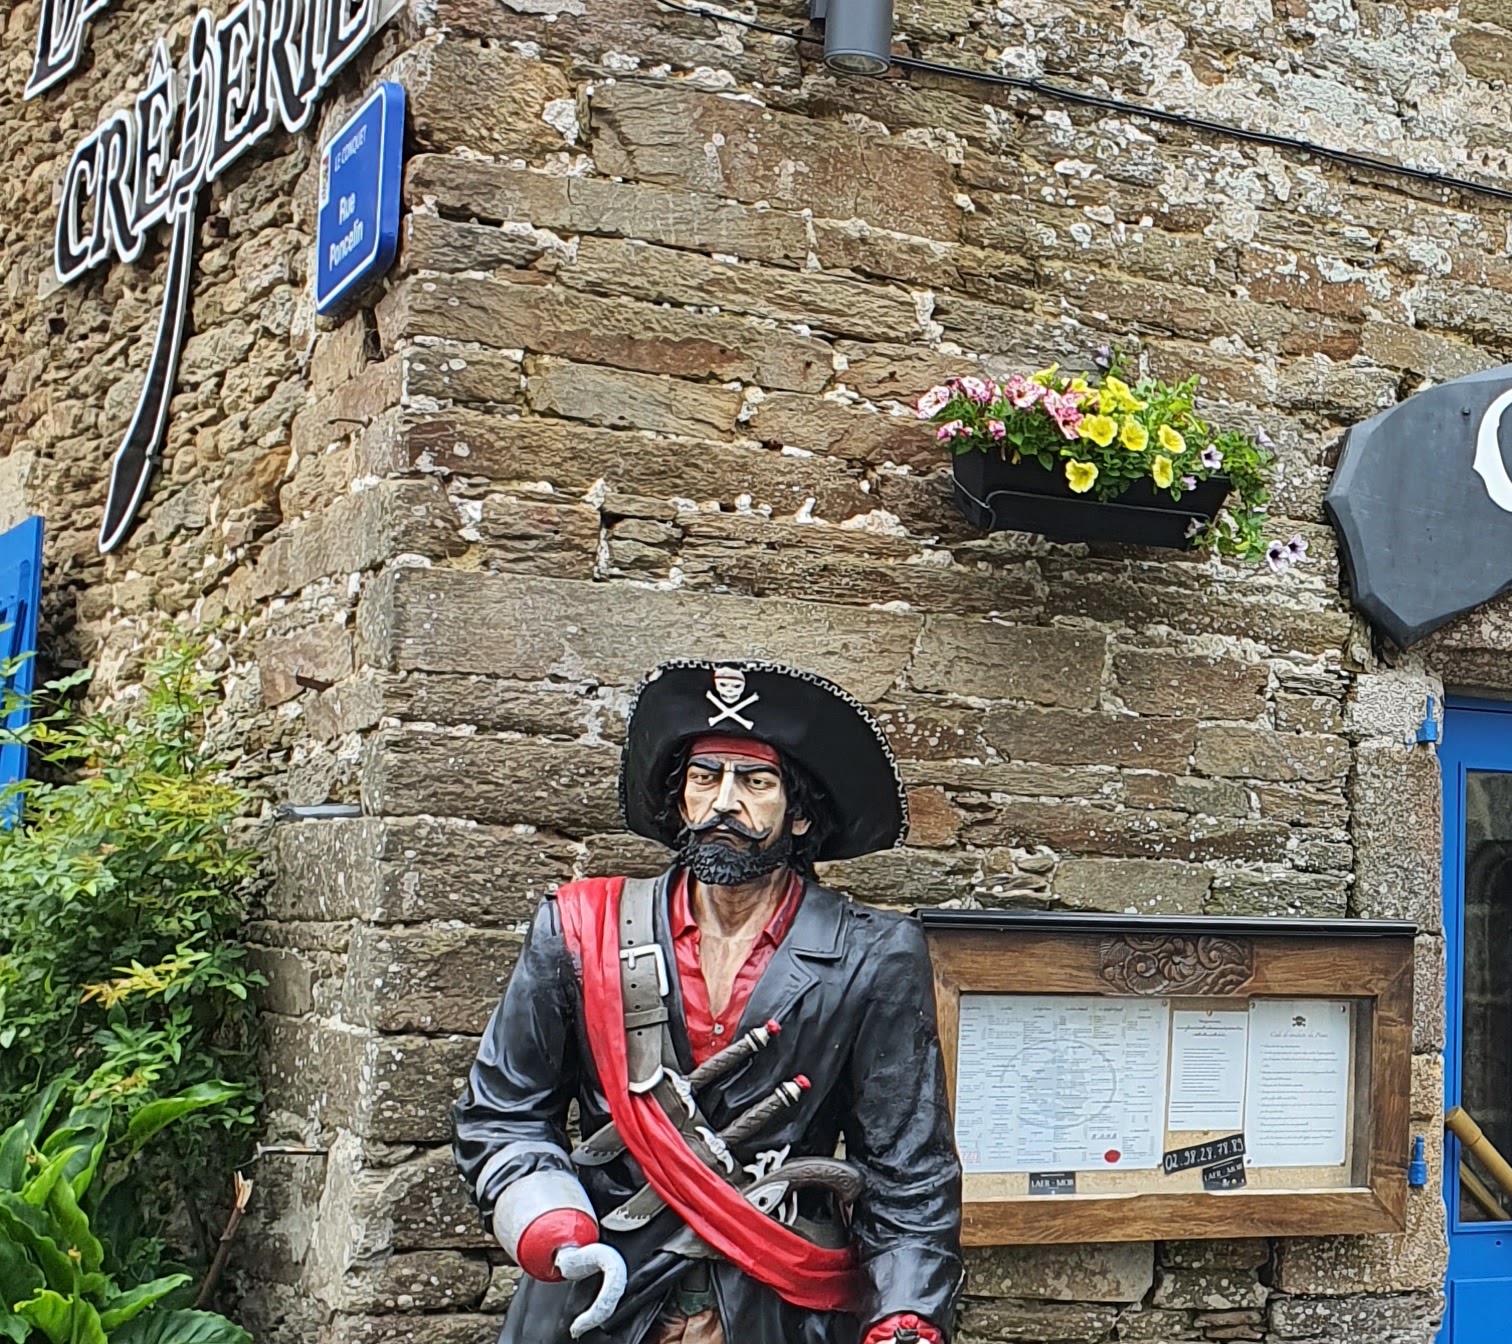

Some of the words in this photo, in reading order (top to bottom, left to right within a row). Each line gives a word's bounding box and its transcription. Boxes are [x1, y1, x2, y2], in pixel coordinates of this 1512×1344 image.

[334, 151, 342, 173] LE
[341, 123, 368, 164] CONQUET
[339, 192, 356, 225] Rue
[329, 217, 364, 272] Poncelin
